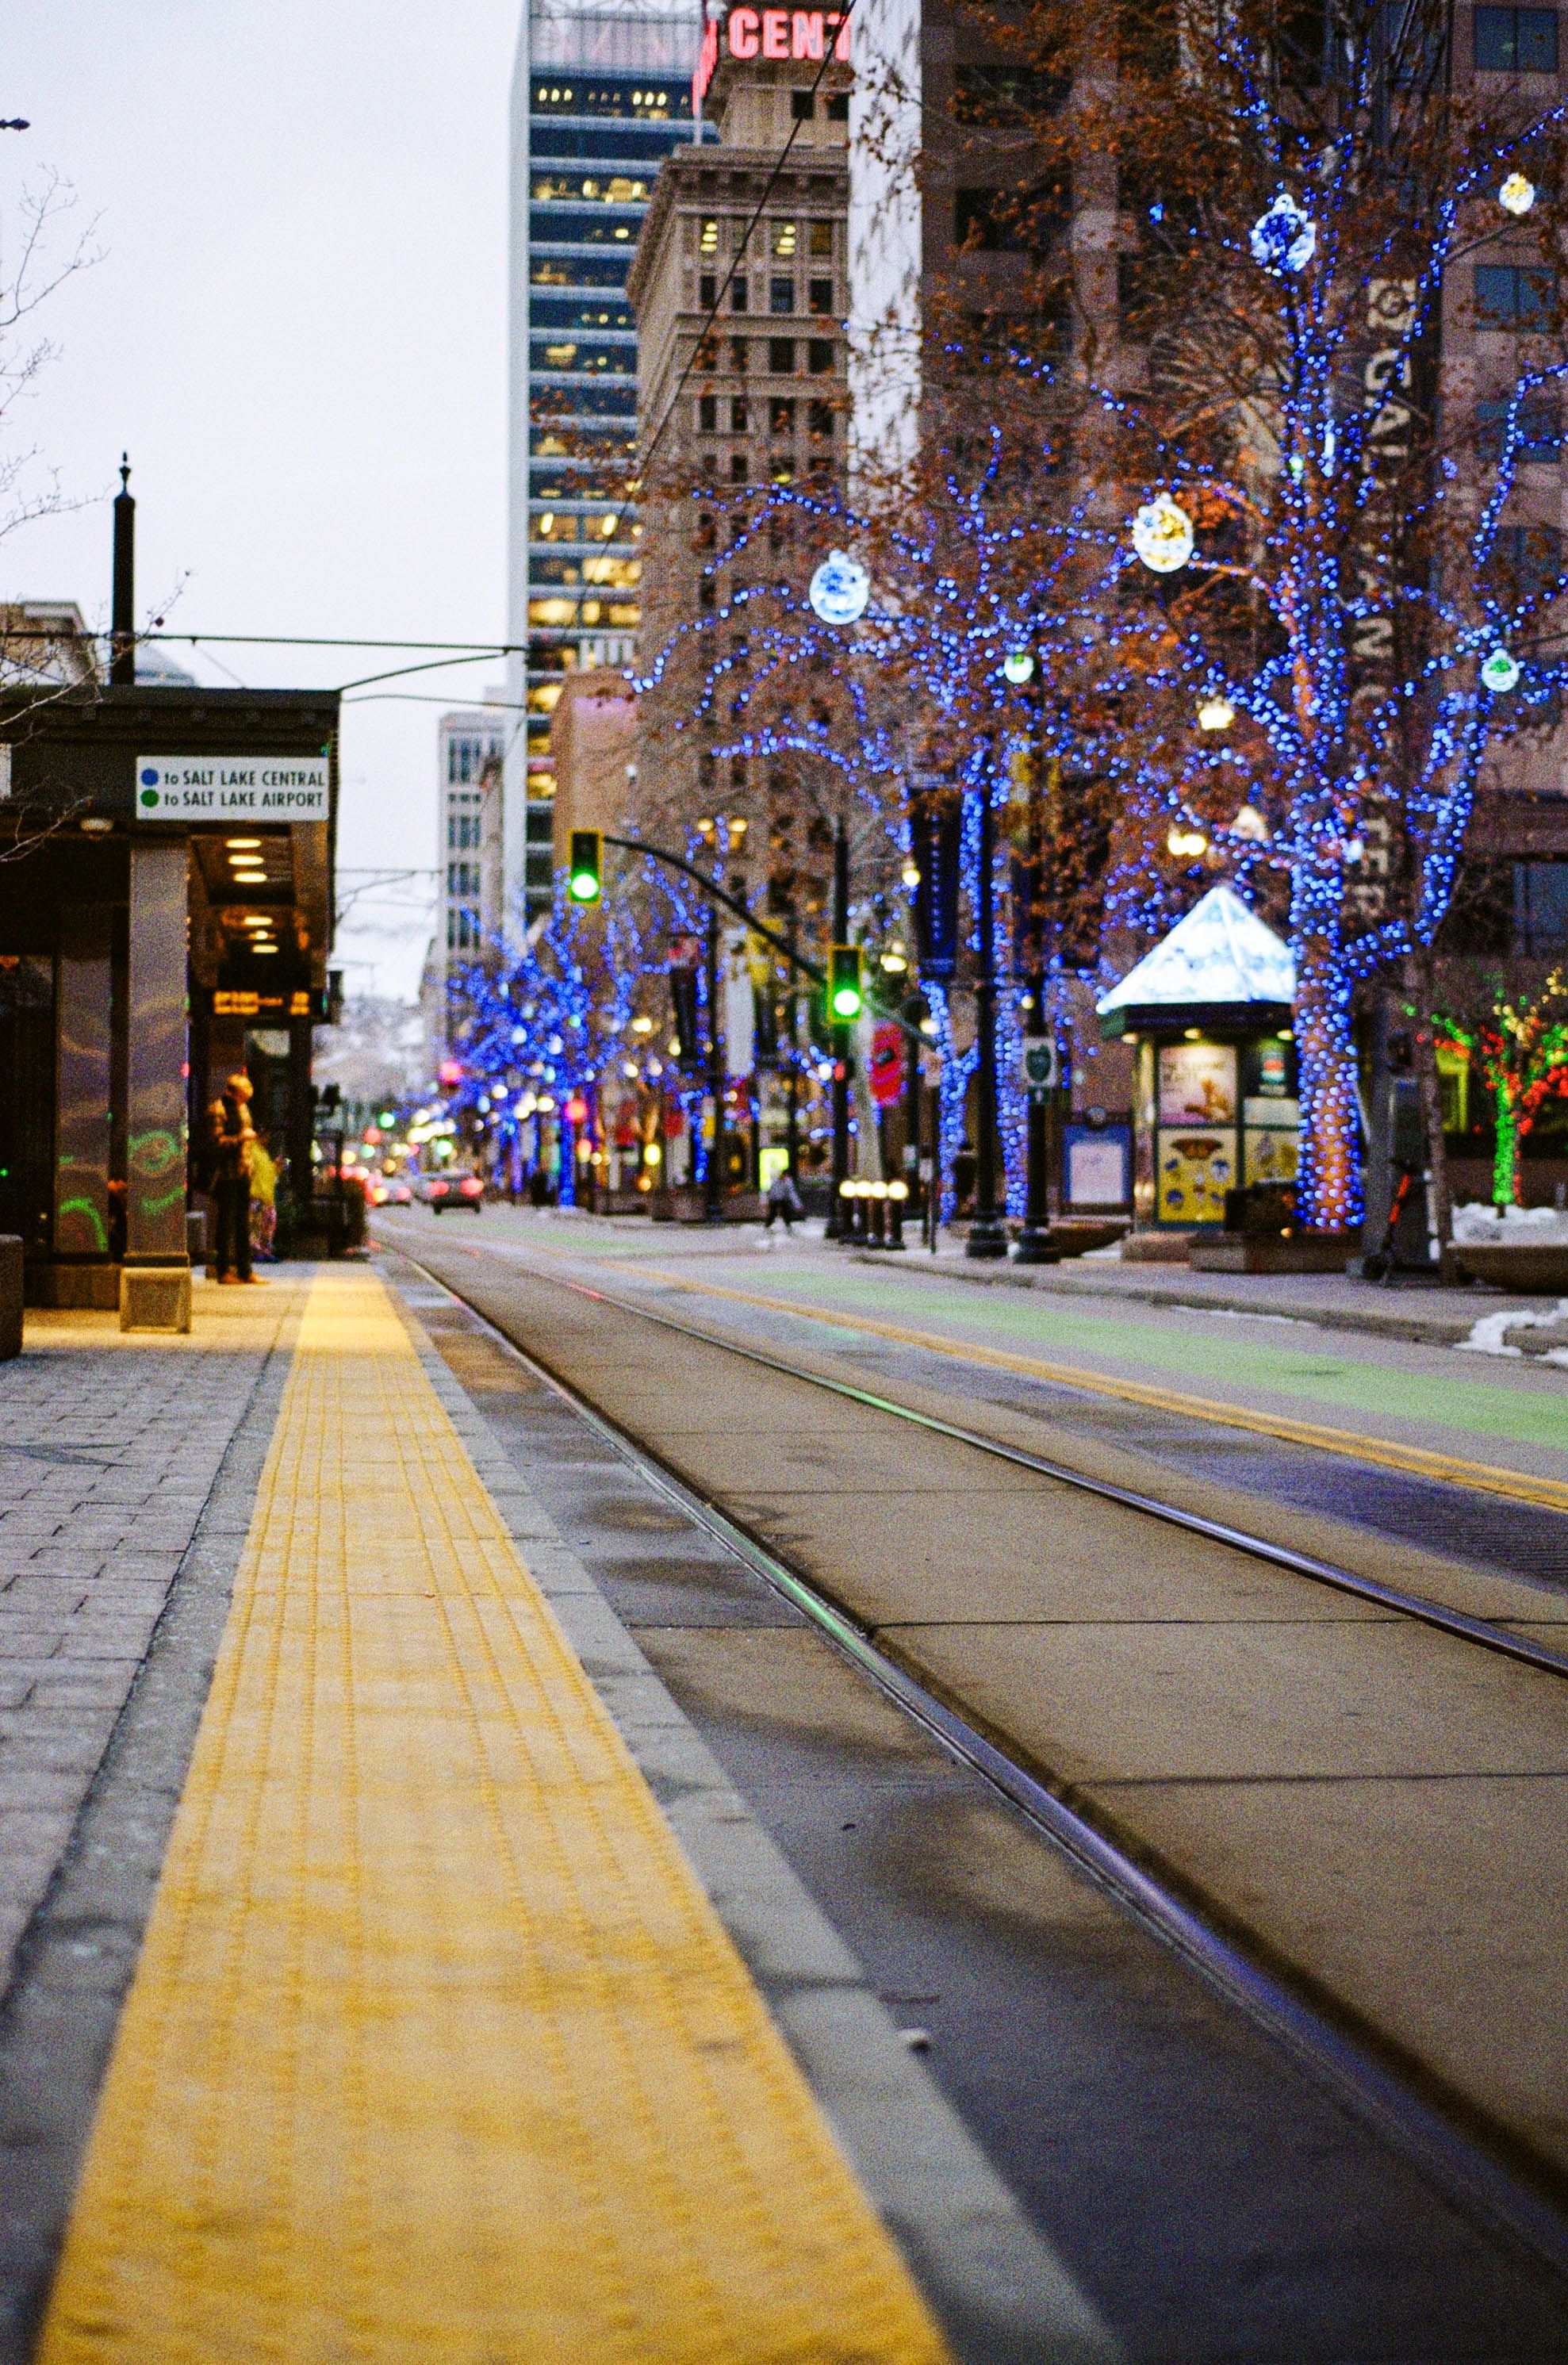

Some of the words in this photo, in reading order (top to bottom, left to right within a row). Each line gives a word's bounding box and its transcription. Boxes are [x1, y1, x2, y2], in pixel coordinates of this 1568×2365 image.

[164, 772, 178, 785] to
[183, 770, 214, 786] SALT
[220, 770, 256, 786] LAKE
[262, 770, 325, 787] CENTRAL
[164, 792, 178, 807] to
[183, 791, 214, 807] SALT
[220, 792, 256, 807] LAKE
[262, 792, 323, 807] AIRPORT
